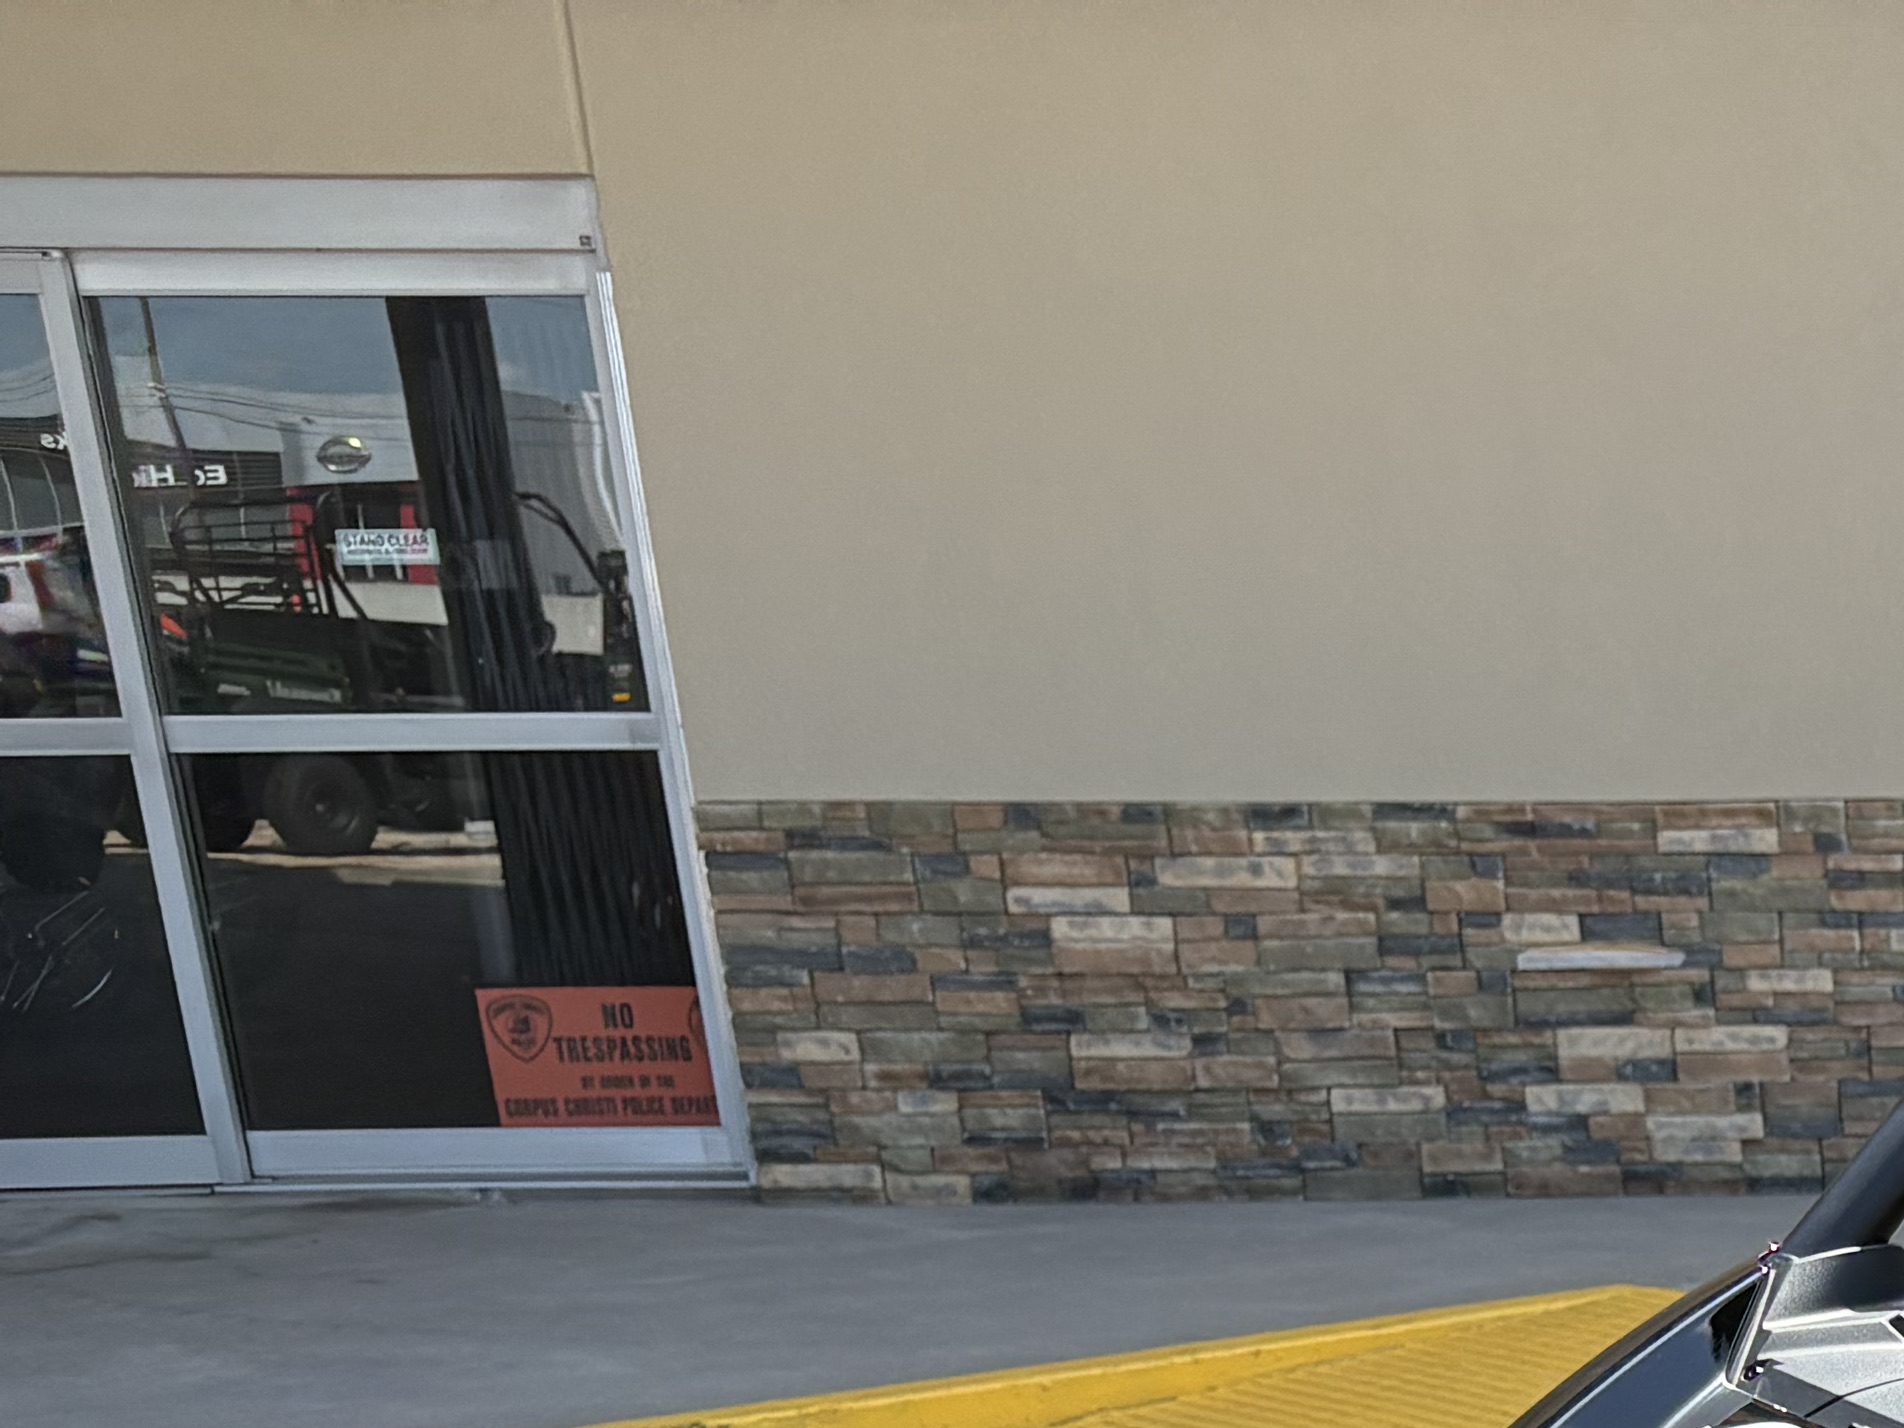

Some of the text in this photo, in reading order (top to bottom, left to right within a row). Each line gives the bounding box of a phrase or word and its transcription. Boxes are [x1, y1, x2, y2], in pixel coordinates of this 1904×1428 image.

[601, 1002, 634, 1029] NO
[553, 1035, 693, 1063] TRESPASSING
[504, 1097, 559, 1118] CORPUS
[564, 1097, 618, 1117] CHRISTI
[622, 1096, 665, 1116] POLICE
